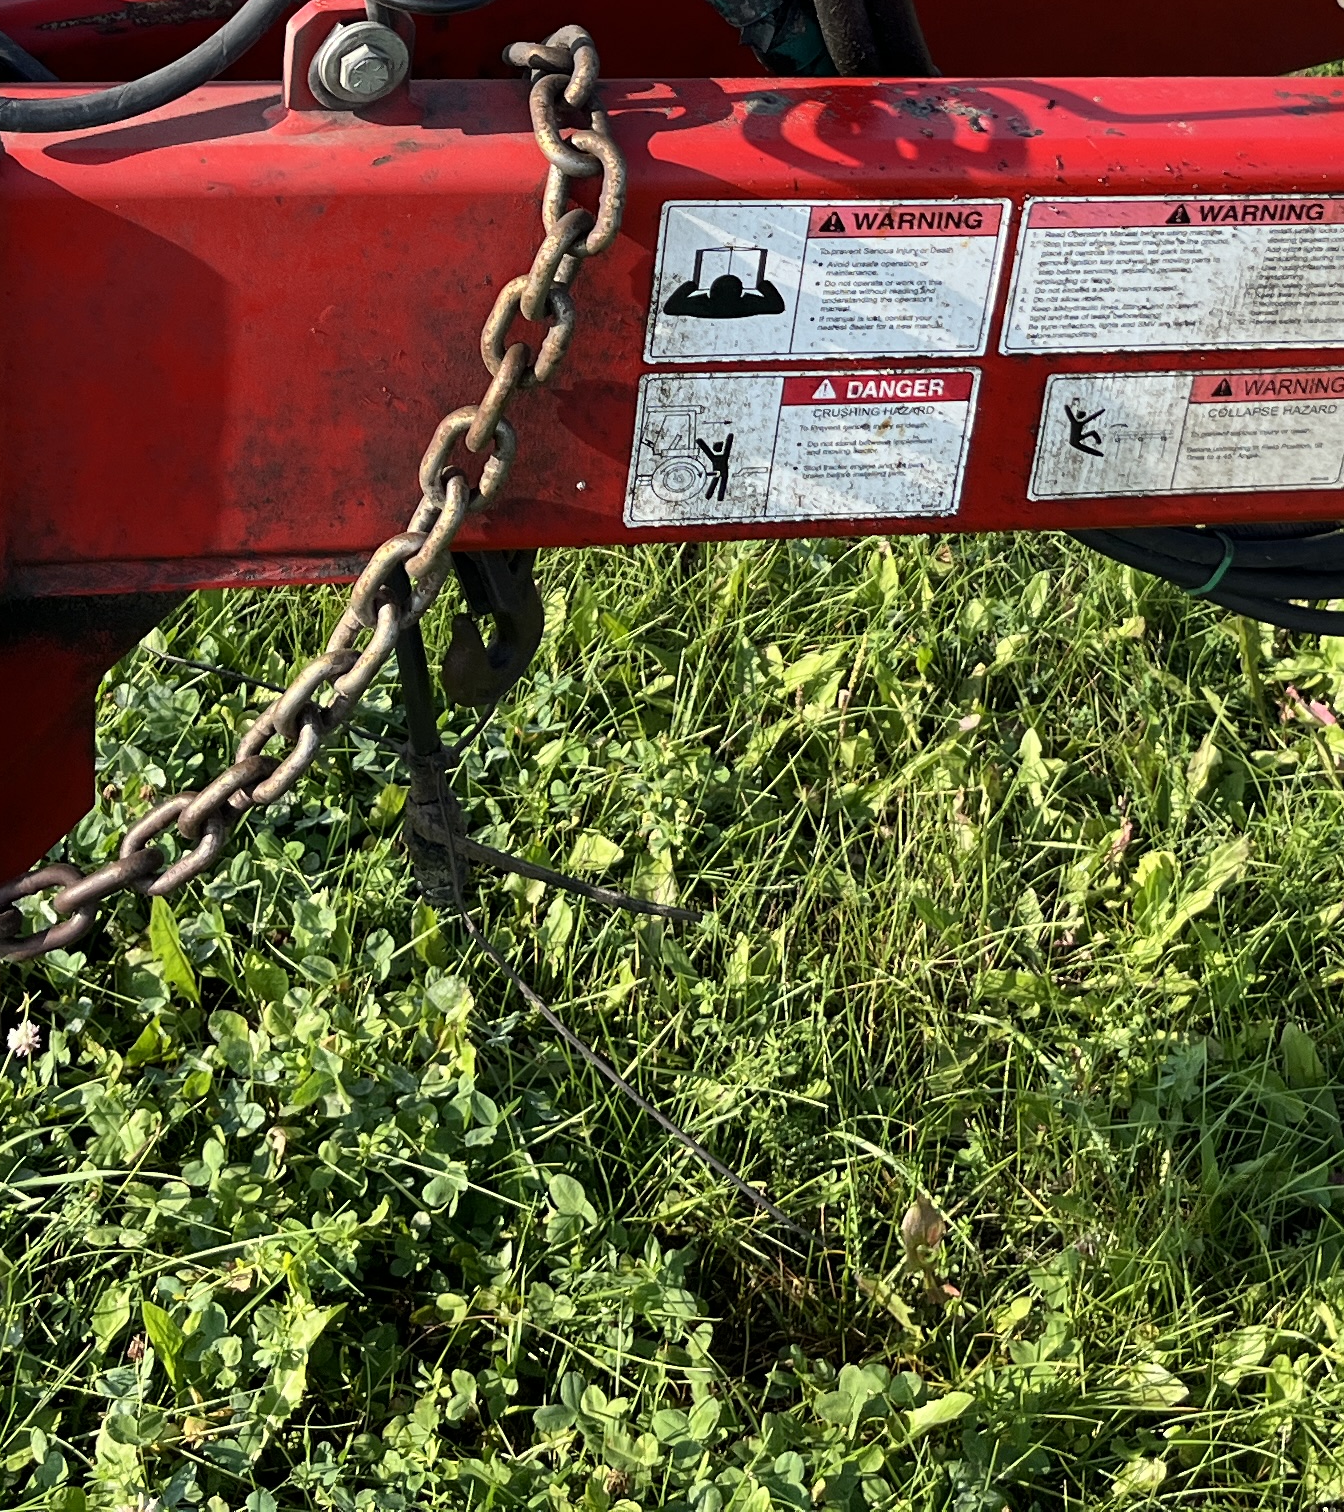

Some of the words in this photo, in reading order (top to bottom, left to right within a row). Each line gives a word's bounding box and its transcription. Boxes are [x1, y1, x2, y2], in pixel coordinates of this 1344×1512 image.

[855, 212, 983, 230] WARNING
[1199, 203, 1325, 223] WARNING
[846, 380, 944, 399] DANGER
[813, 408, 880, 418] CRUSHING
[884, 406, 934, 415] HAZARD
[1208, 406, 1279, 418] COLLAPSE
[1283, 405, 1337, 415] HAZARD
